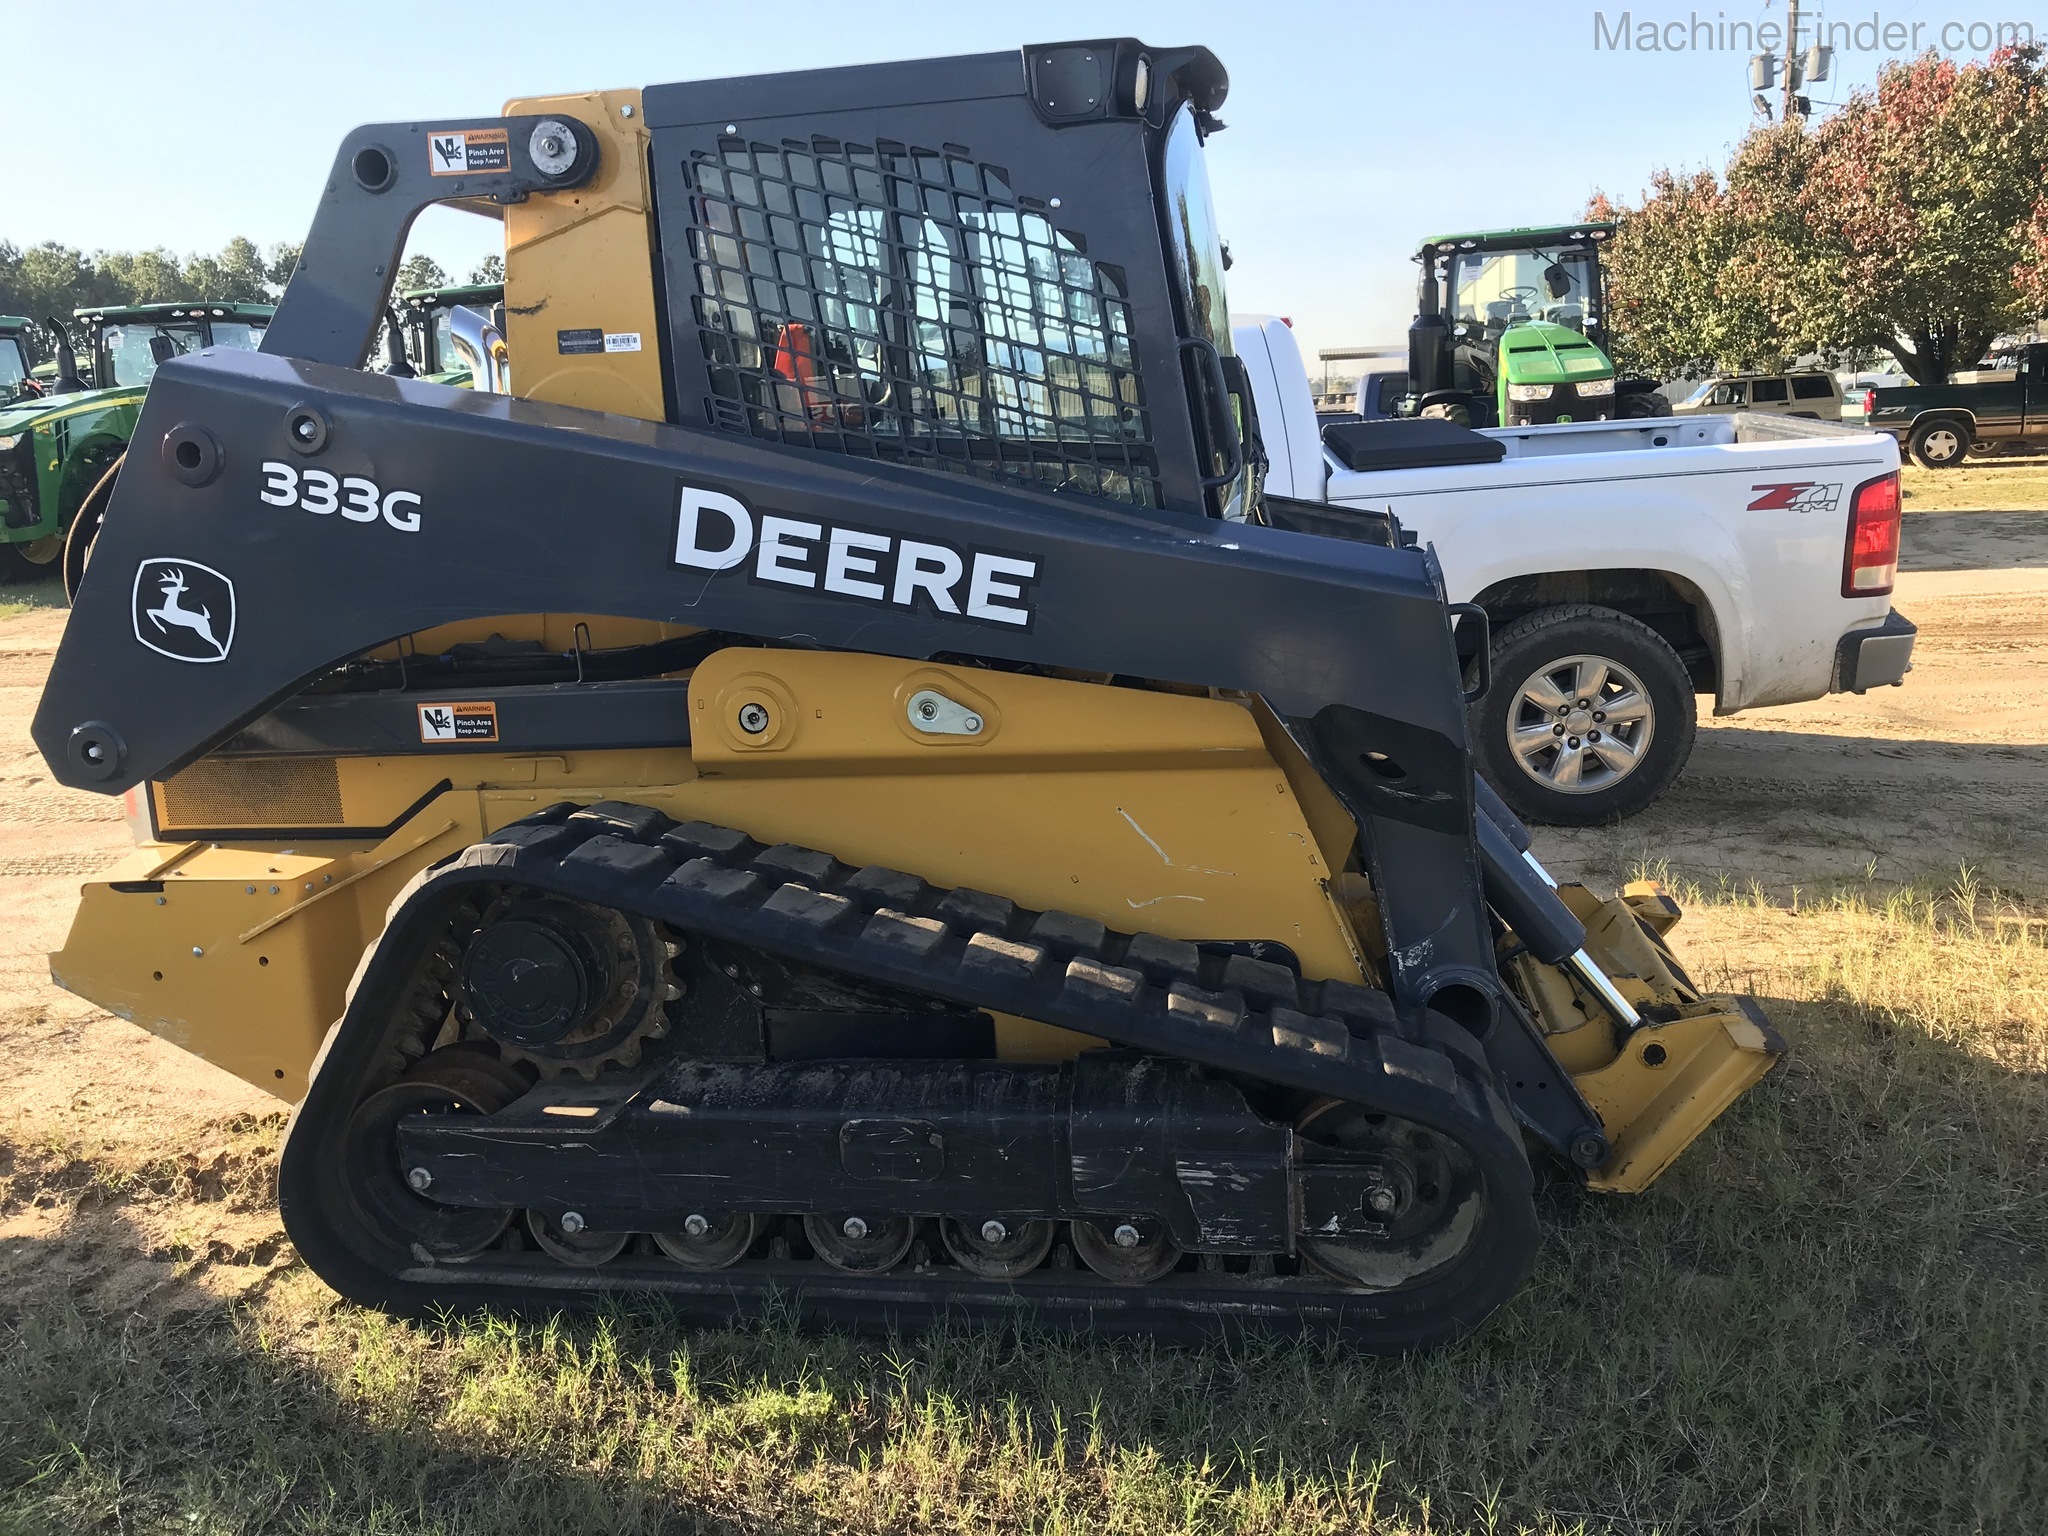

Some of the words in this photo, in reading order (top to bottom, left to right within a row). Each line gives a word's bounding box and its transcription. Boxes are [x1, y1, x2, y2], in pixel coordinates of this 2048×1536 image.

[468, 149, 488, 157] Pinch
[469, 158, 484, 166] Keep
[260, 462, 422, 532] 333G
[1746, 481, 1843, 512] Z71
[674, 486, 1036, 626] DEERE
[456, 719, 476, 727] Pinch
